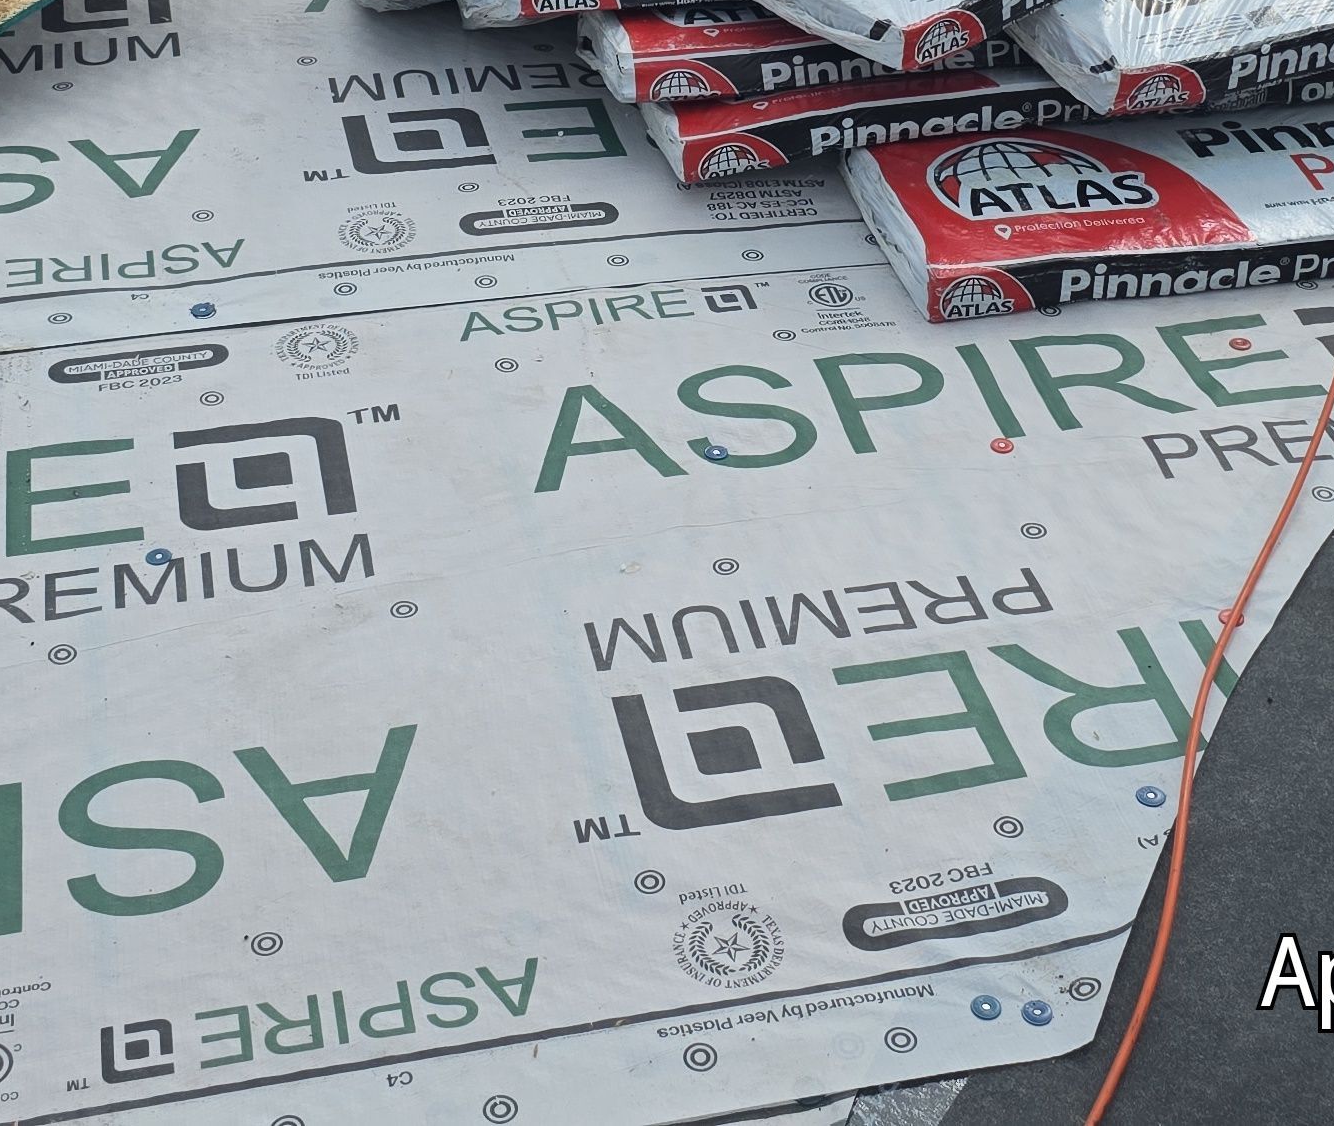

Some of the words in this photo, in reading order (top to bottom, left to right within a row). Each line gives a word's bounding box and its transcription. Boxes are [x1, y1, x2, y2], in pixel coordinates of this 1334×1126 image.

[919, 31, 969, 63] ATLAS
[1131, 88, 1190, 111] ATLAS
[811, 105, 1024, 156] Pinnacle
[303, 168, 349, 184] TM
[497, 197, 536, 207] 2023
[546, 194, 571, 204] FBC
[709, 190, 757, 201] D8257
[760, 188, 803, 199] ASTM
[969, 173, 1155, 217] ATLAS
[347, 203, 379, 214] Listed
[509, 206, 568, 217] APPROVED
[707, 202, 729, 212] 188
[732, 200, 757, 210] AC
[741, 207, 818, 219] CERTIFIED
[759, 198, 814, 209] ICC-ES
[478, 216, 527, 228] COUNTY
[528, 210, 602, 224] MIAMI-DADE
[710, 210, 738, 221] TO:
[1014, 219, 1081, 234] Protection
[5, 238, 246, 289] ASPIRE
[373, 265, 404, 275] Veer
[407, 260, 422, 271] by
[423, 253, 515, 270] Manufactured
[318, 268, 371, 280] Plastics
[1060, 261, 1281, 303] Pinnacle
[460, 289, 695, 342] ASPIRE
[817, 311, 864, 320] Intertek
[945, 298, 1014, 319] ATLAS
[68, 357, 149, 374] MIAMI-DADE
[153, 350, 209, 365] COUNTY
[107, 364, 175, 379] APPROVED
[98, 380, 136, 392] FBC
[139, 374, 183, 388] 2023
[295, 371, 314, 381] TDI
[317, 367, 351, 379] Listed
[534, 314, 1320, 493] ASPIRE
[348, 404, 401, 426] TM
[584, 567, 1055, 672] PREMIUM
[573, 813, 642, 844] TM
[949, 862, 994, 881] FBC
[723, 883, 749, 896] TDI
[888, 871, 945, 896] 2023
[678, 886, 722, 905] Listed
[909, 885, 990, 914] APPROVED
[687, 900, 749, 924] APPROVED
[943, 891, 1046, 923] MIAMI-DADE
[761, 914, 785, 946] TEXAS
[870, 911, 940, 936] COUNTY
[672, 931, 707, 983] INSURANCE
[724, 947, 785, 989] DEPARTMENT
[705, 977, 722, 988] OF
[806, 982, 936, 1017] Manufactured
[192, 957, 539, 1072] ASPIRE
[736, 1008, 779, 1027] Veer
[780, 1001, 804, 1020] by
[656, 1017, 734, 1040] Plastics
[66, 1077, 91, 1092] TM
[386, 1071, 415, 1088] C4
